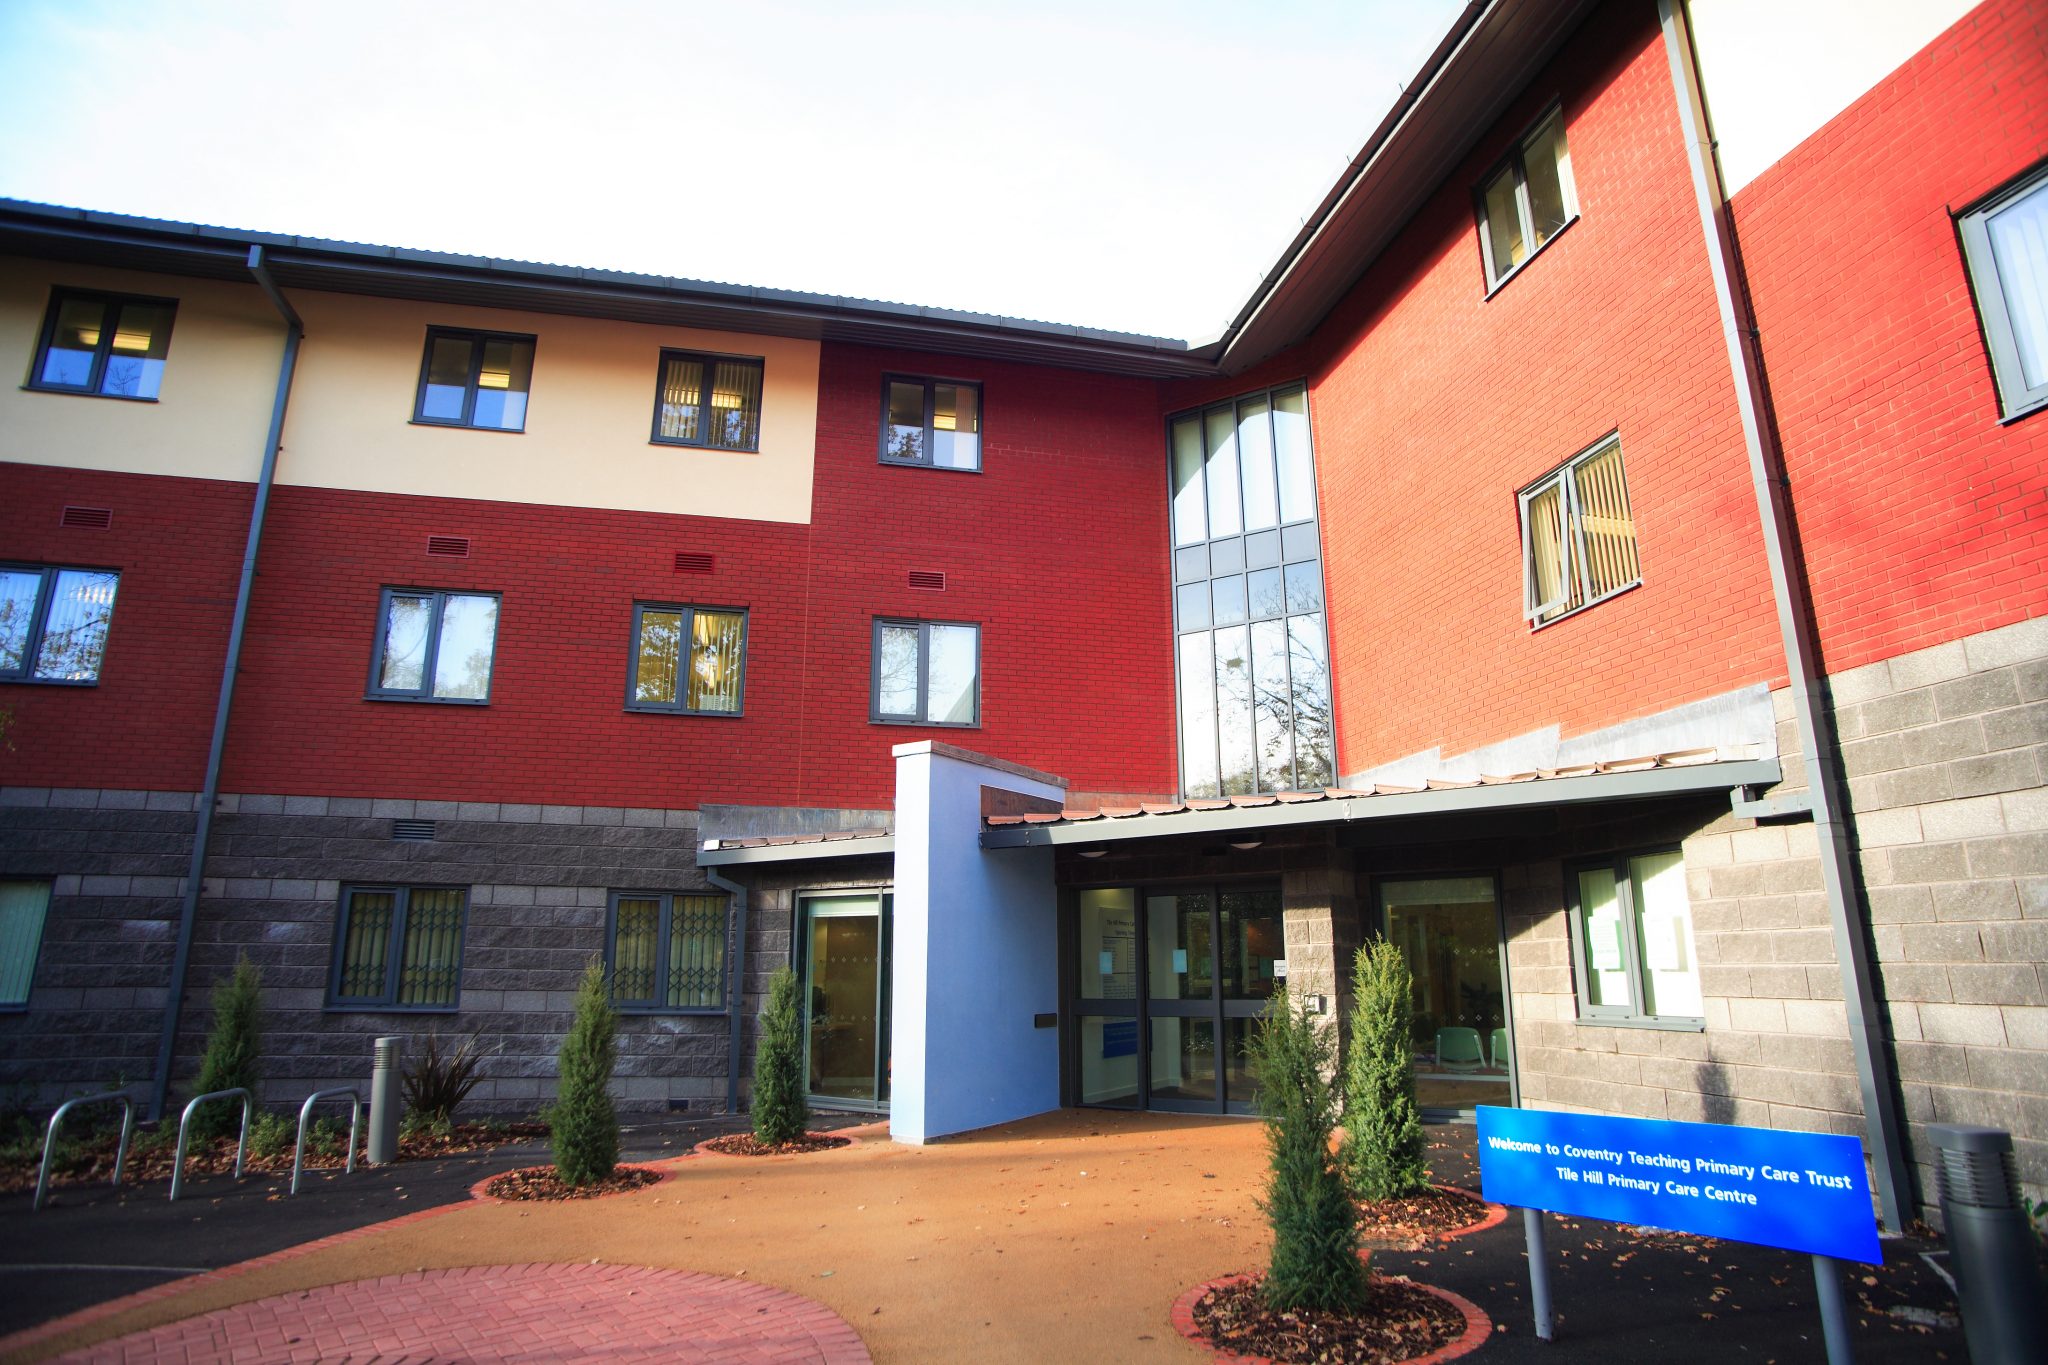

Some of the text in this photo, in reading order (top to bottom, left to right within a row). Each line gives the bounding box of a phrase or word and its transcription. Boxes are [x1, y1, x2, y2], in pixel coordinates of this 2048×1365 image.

[1488, 1136, 1853, 1190] Welcome to Coventry Teaching Primary Care Trust
[1556, 1167, 1757, 1205] Tile Hill Primary Care Centre
